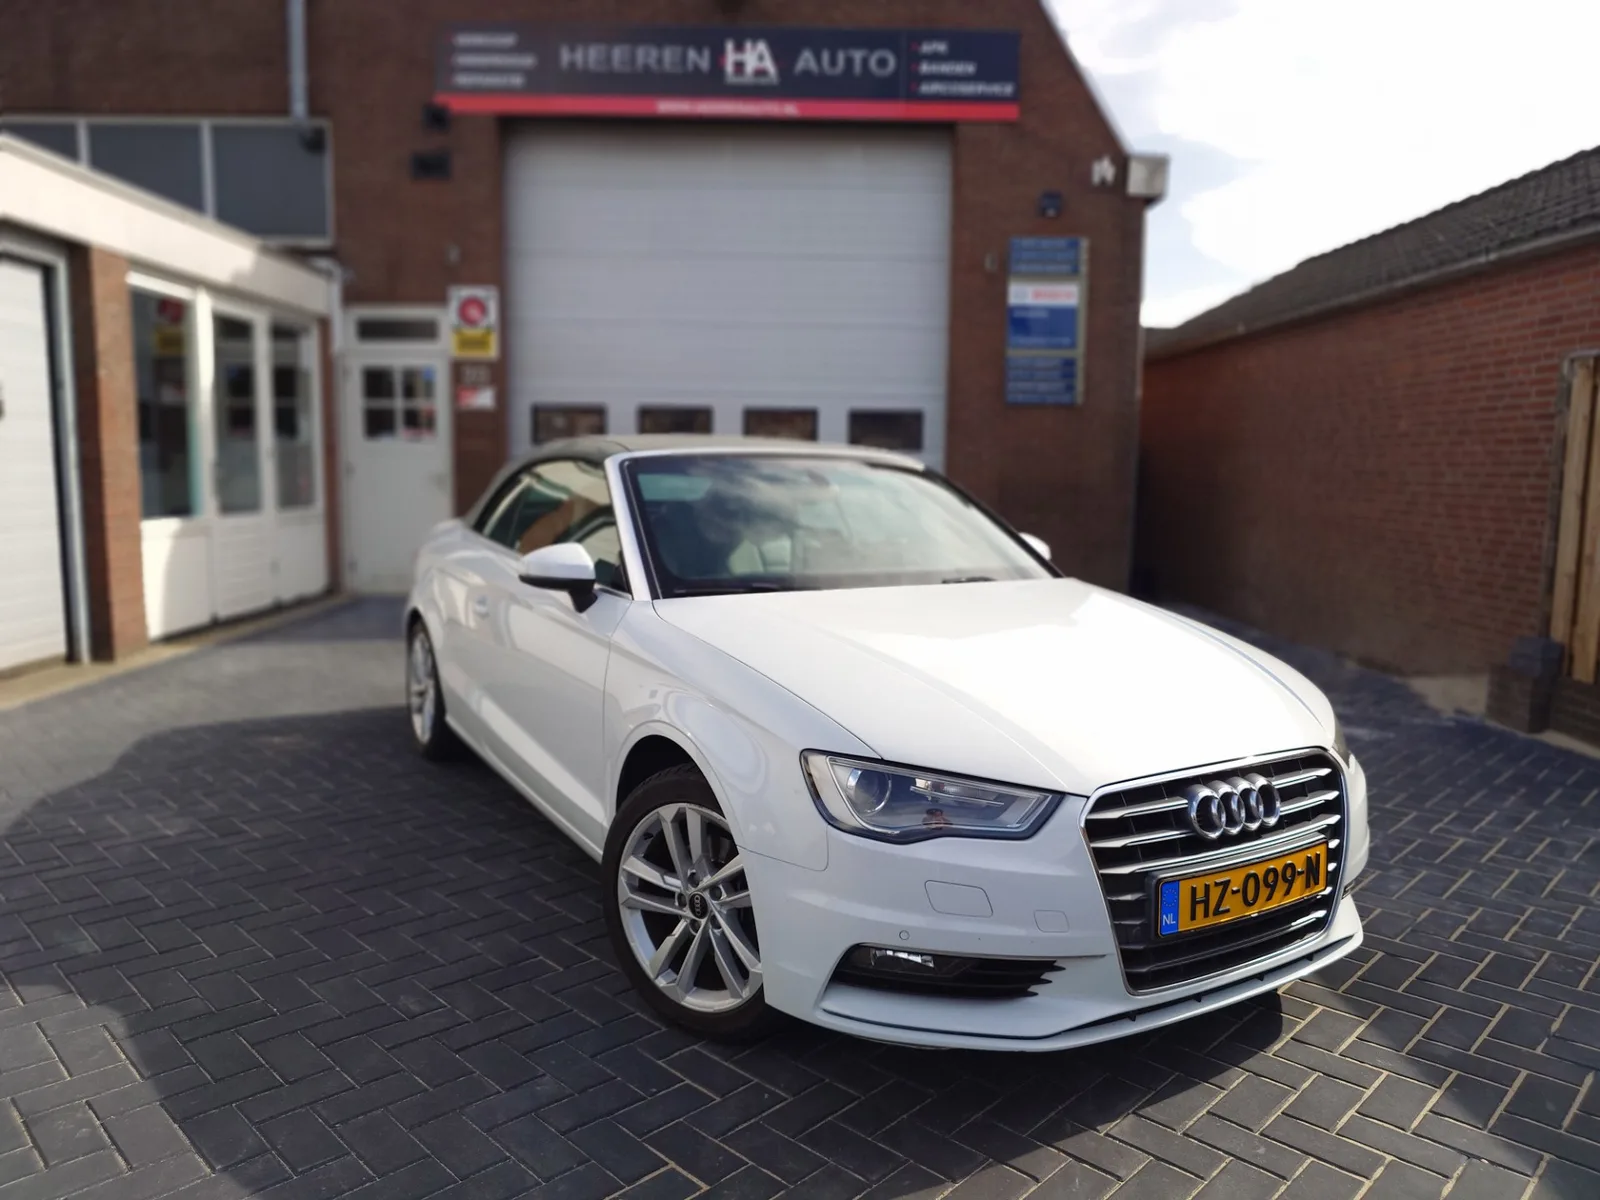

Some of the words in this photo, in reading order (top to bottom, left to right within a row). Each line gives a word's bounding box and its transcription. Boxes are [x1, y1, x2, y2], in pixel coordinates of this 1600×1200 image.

[559, 44, 711, 73] HEEREN
[724, 39, 778, 79] HA
[793, 48, 897, 77] AUTO
[1190, 851, 1321, 921] HZ-099-N
[1162, 914, 1176, 926] NL
